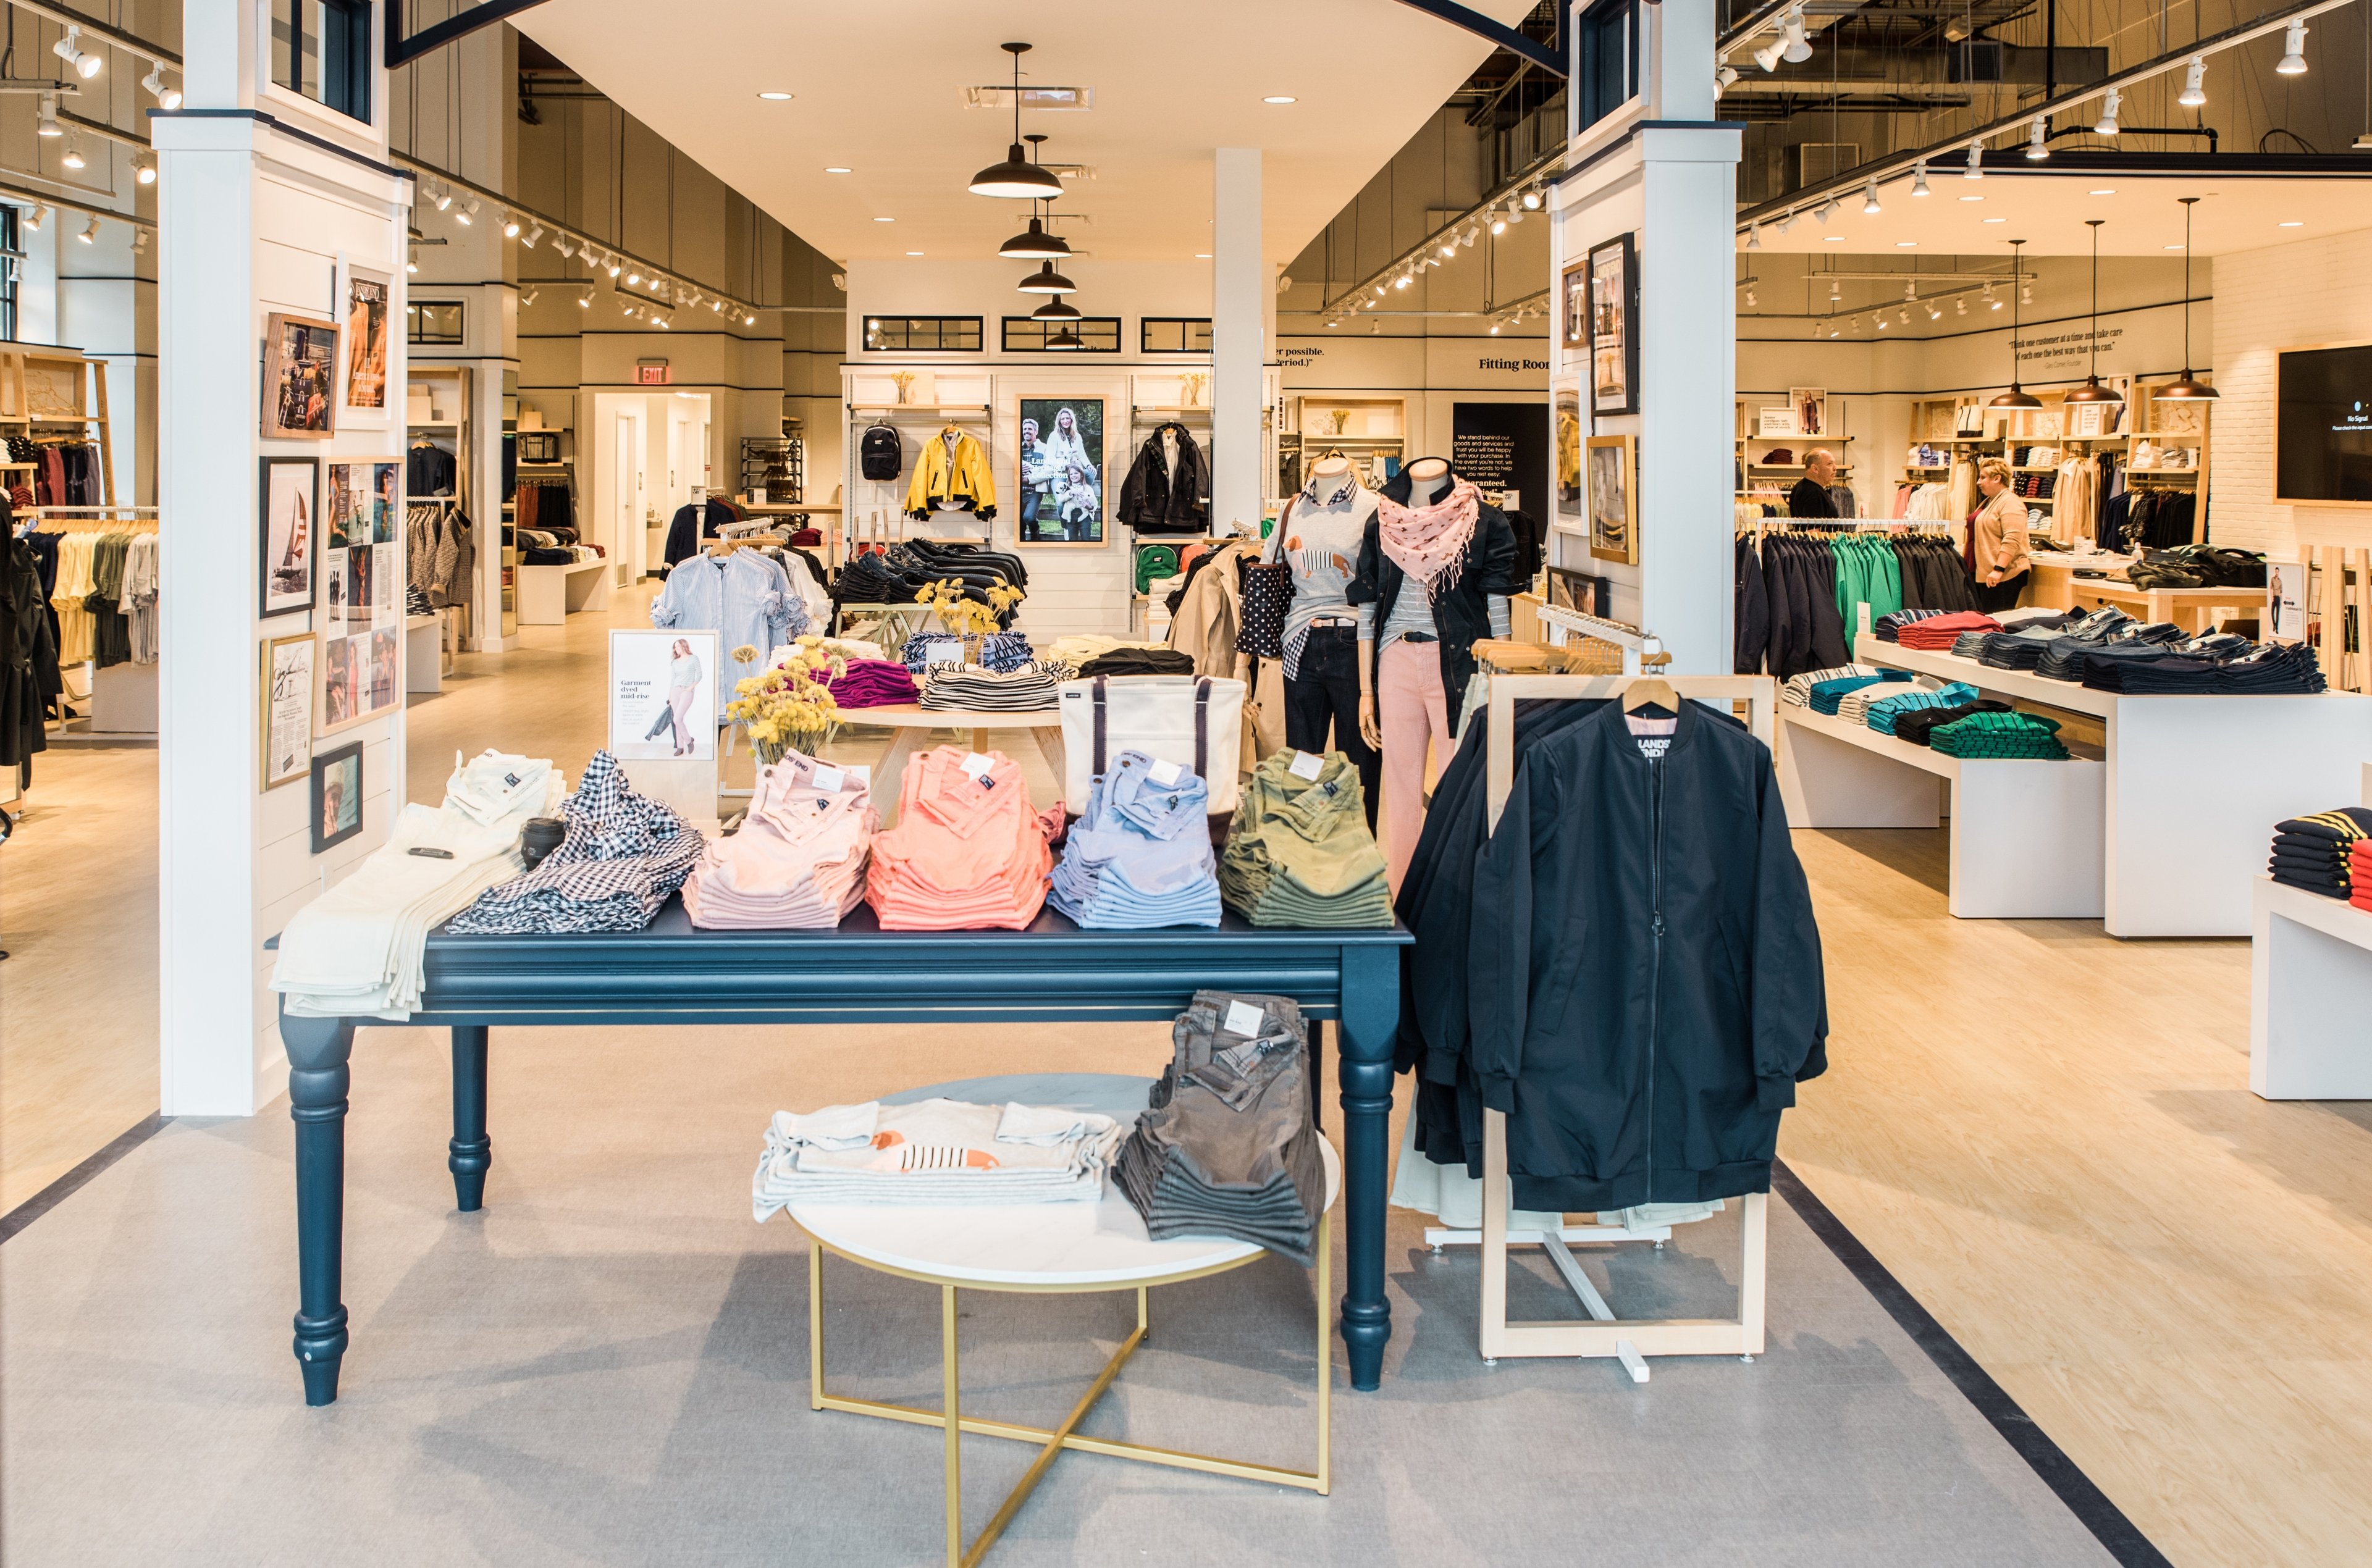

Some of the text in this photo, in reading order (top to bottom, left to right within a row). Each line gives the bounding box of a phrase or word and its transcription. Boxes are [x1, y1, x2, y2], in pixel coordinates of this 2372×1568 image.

[2036, 337, 2059, 346] customer
[2071, 332, 2084, 342] time
[2097, 329, 2109, 338] take
[2110, 329, 2122, 337] care
[1285, 348, 1324, 357] possible.
[2021, 351, 2033, 360] each
[2043, 349, 2051, 358] the
[2053, 348, 2063, 356] best
[2064, 348, 2076, 356] way
[2077, 345, 2088, 354] that
[1479, 358, 1520, 372] Fitting
[643, 367, 663, 382] EXIT
[2355, 414, 2368, 423] Signal
[1638, 739, 1671, 749] LANDS'
[794, 760, 809, 771] END
